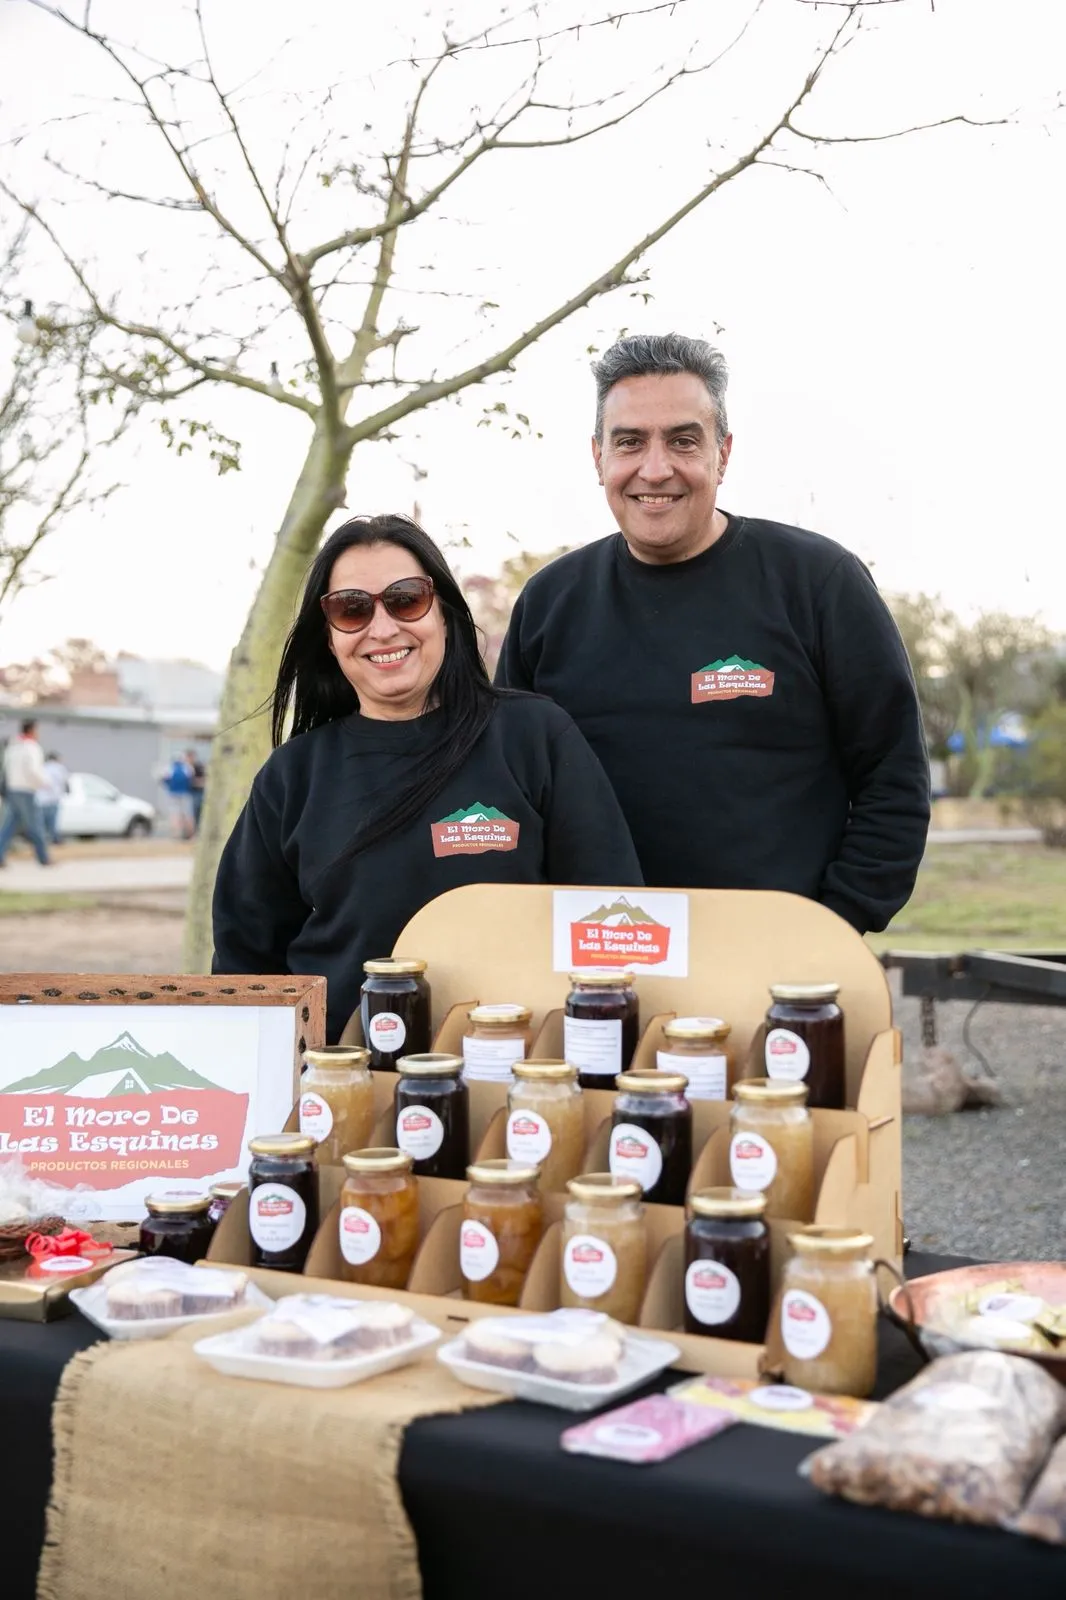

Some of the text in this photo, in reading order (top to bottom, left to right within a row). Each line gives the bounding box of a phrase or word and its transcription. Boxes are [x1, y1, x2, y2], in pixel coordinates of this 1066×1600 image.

[461, 825, 490, 833] Moro
[440, 833, 512, 843] Las Esquinas
[586, 928, 652, 941] El Moro De
[579, 939, 660, 953] Las Esquinas
[23, 1104, 200, 1128] El Moro De
[0, 1129, 219, 1157] Las Esquinas
[30, 1159, 190, 1172] PRODUCTOS REGIONALES
